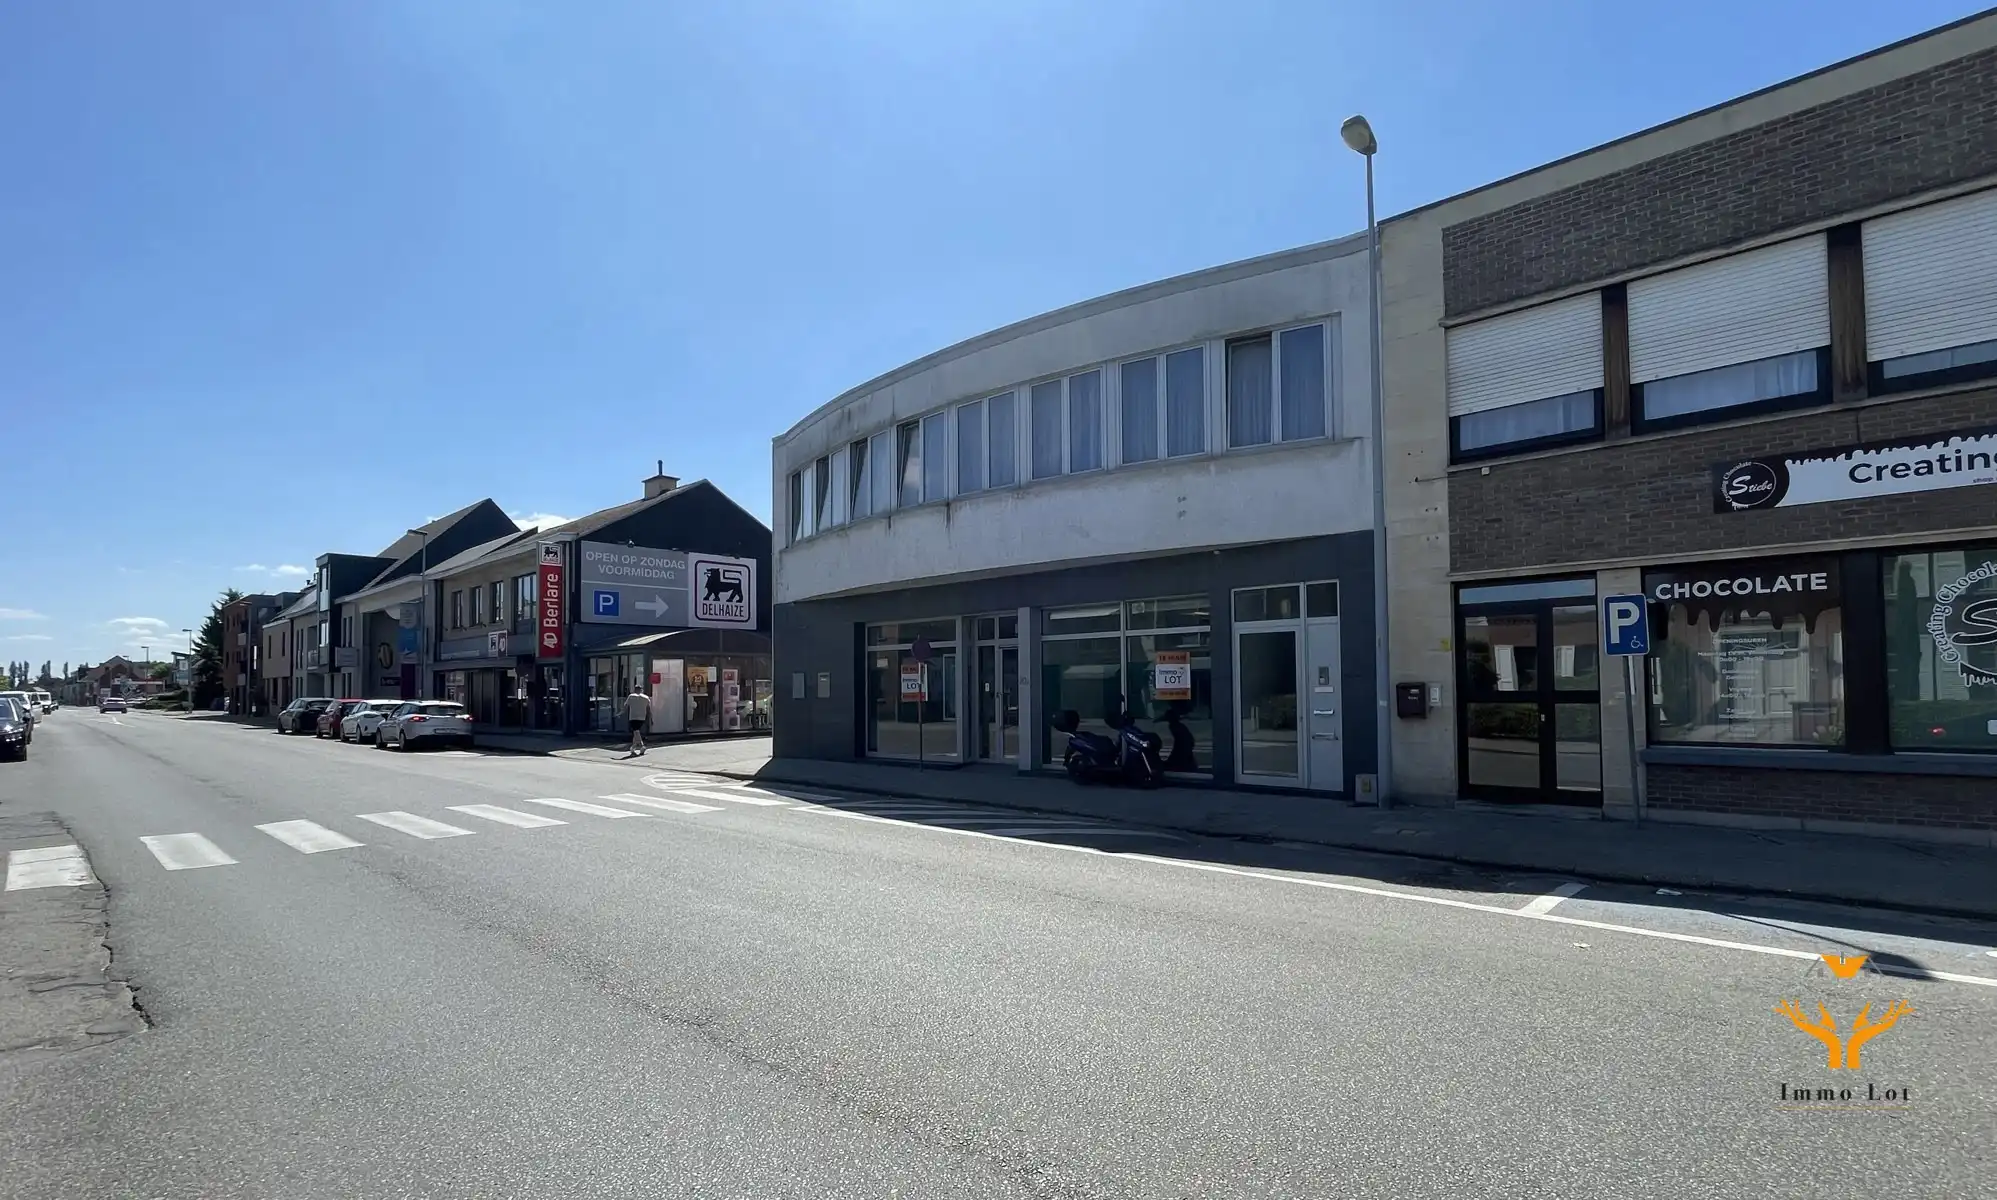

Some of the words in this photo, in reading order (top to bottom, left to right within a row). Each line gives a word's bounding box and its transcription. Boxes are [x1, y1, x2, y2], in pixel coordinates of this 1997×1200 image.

[1848, 449, 1997, 484] Creatin
[585, 551, 618, 563] OPEN
[621, 554, 638, 565] OP
[640, 556, 686, 570] ZONDAG
[597, 564, 676, 580] VOORMIDDAG
[1655, 572, 1828, 600] CHOCOLATE
[543, 573, 559, 628] Berlare
[599, 594, 614, 613] P
[702, 602, 745, 618] DELHAIZE
[1608, 601, 1640, 644] P
[1926, 603, 1962, 664] Creating
[1164, 675, 1182, 684] LOT
